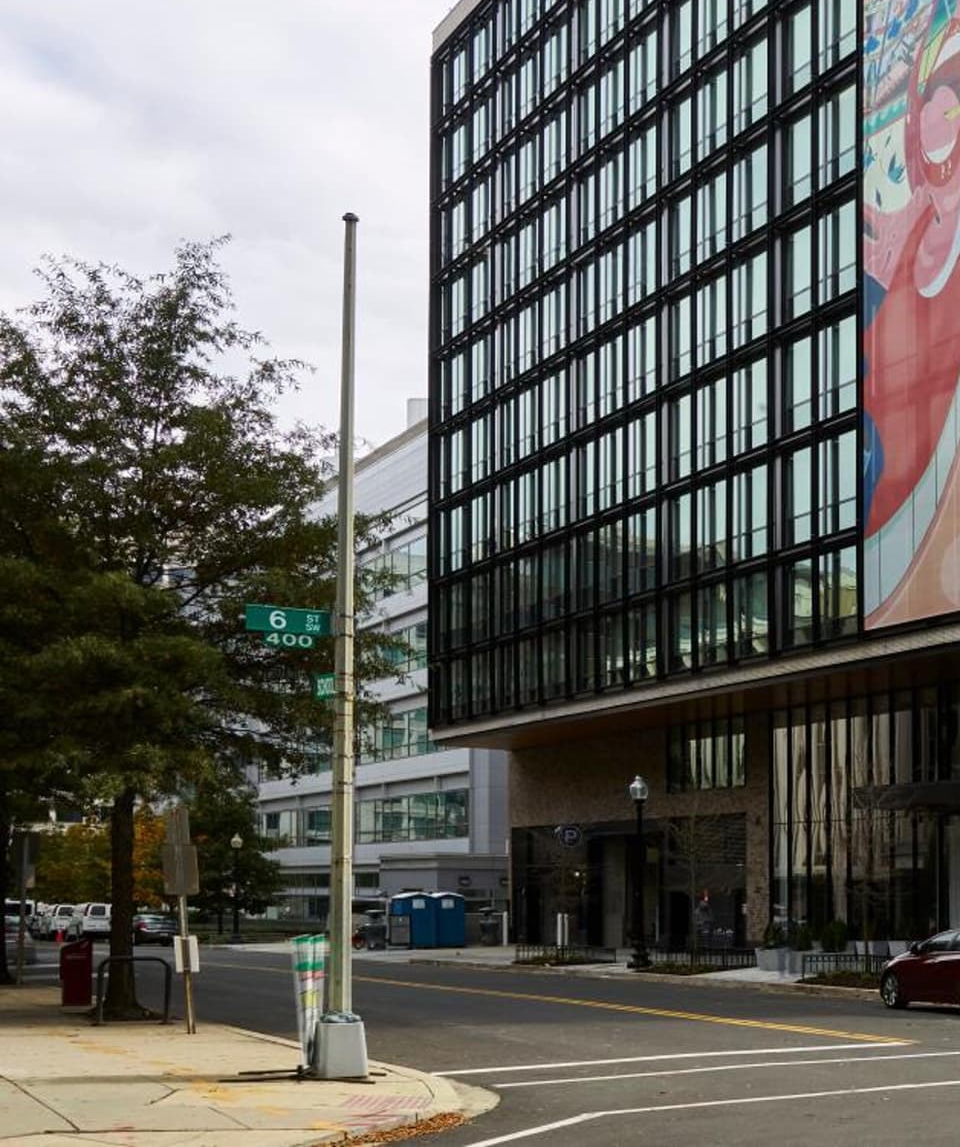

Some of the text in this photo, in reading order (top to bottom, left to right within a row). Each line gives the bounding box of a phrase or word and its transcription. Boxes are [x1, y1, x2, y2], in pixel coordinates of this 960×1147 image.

[269, 610, 320, 629] 6 ST
[305, 623, 320, 631] SW
[266, 633, 313, 647] 400
